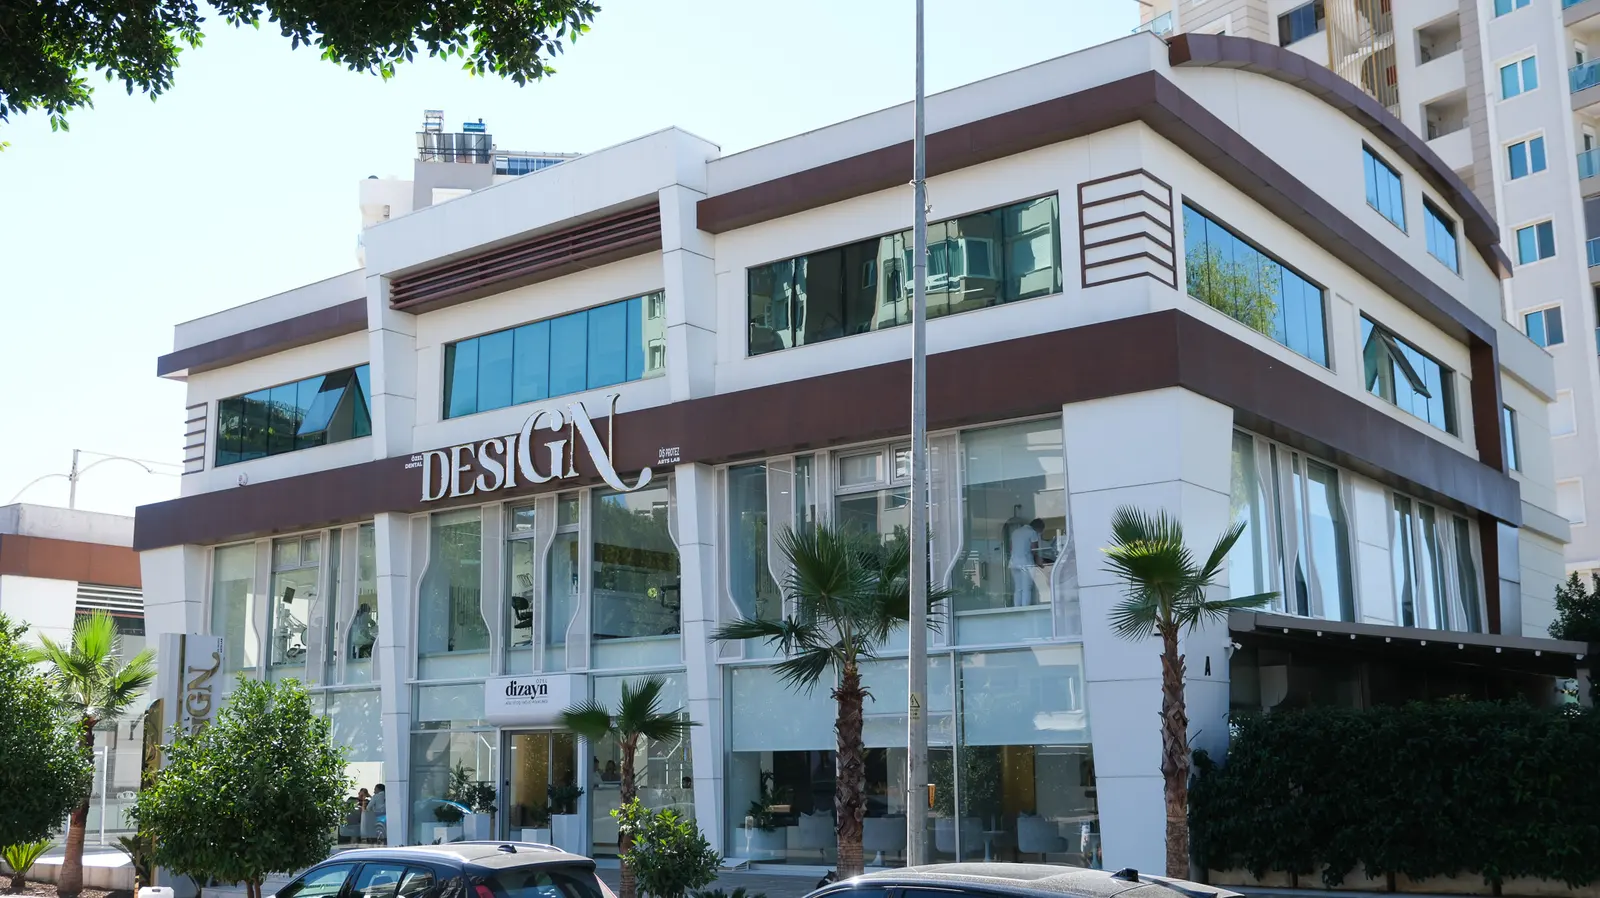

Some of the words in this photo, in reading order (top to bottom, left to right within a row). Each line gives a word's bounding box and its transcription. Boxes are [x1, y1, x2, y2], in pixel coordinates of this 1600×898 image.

[420, 393, 652, 502] DESIGN
[404, 461, 423, 469] DENTAL
[1204, 655, 1211, 677] A
[186, 652, 220, 738] SIGN
[506, 680, 548, 699] dizayn
